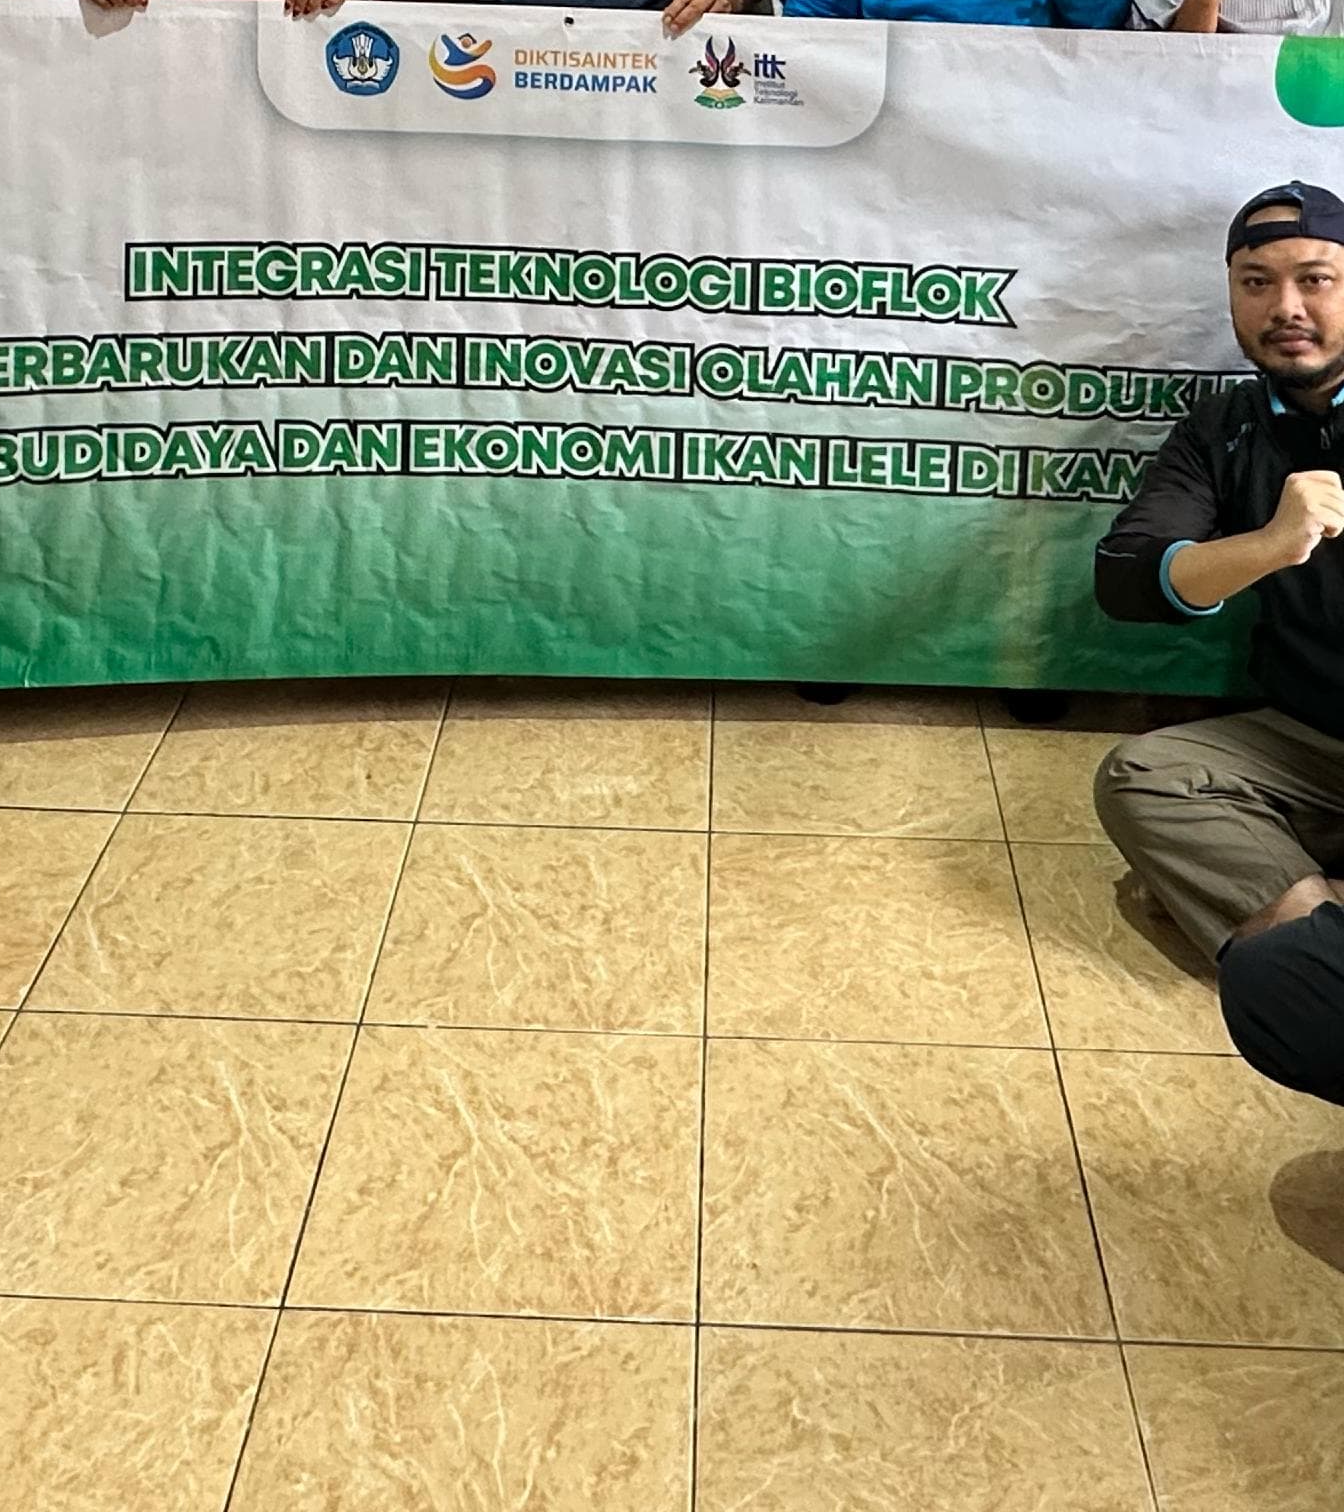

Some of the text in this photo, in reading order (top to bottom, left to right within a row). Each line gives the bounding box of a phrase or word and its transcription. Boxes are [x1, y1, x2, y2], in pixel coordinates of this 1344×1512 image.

[514, 49, 657, 69] DIKTISAINTEK
[514, 71, 657, 93] BERDAMPAK
[754, 53, 786, 79] itk
[130, 245, 1011, 324] INTEGRASI TEKNOLOGI BIOFLOK
[336, 335, 455, 388] DAN
[463, 336, 693, 392] INOVASI
[699, 346, 940, 409] OLAHAN
[945, 361, 1190, 418] PRODUK
[278, 424, 402, 476] DAN
[411, 424, 674, 480] EKONOMI
[683, 431, 818, 486] IKAN
[827, 442, 953, 493] LELE
[957, 450, 1023, 497] DI
